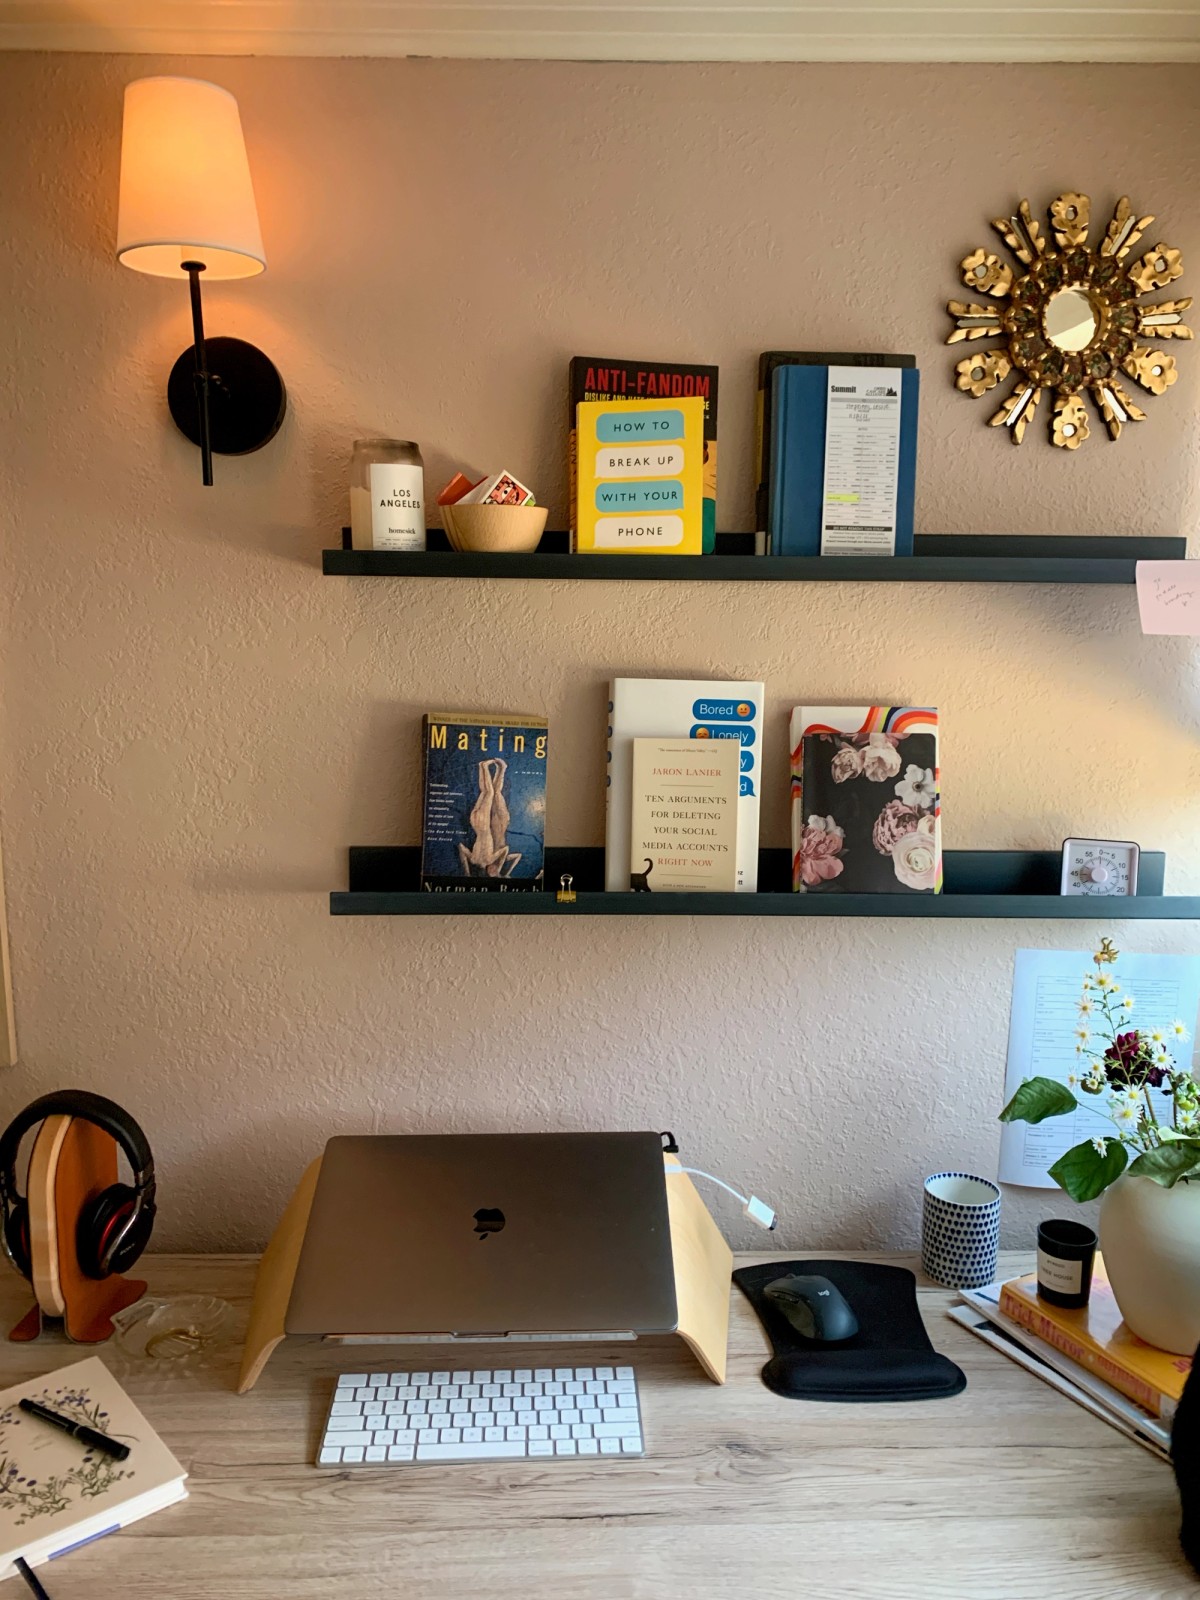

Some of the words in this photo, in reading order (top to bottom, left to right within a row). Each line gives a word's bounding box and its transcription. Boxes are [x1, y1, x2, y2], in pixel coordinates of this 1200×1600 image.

[584, 368, 710, 398] ANTI-FANDOM
[831, 385, 856, 393] Summit
[584, 392, 610, 401] DISLIKE
[614, 422, 646, 432] HOW
[652, 421, 670, 430] TO
[609, 457, 650, 467] BREAK
[657, 456, 674, 465] UP
[393, 489, 411, 497] LOS
[602, 492, 636, 502] WITH
[644, 491, 678, 500] YOUR
[380, 499, 421, 508] ANGELES
[618, 526, 663, 536] PHONE
[700, 704, 733, 715] Bored
[431, 725, 547, 758] Mating
[712, 730, 748, 743] Lonely
[686, 769, 722, 777] LANIER
[667, 795, 727, 804] ARGUMENTS
[651, 810, 669, 819] FOR
[672, 811, 721, 820] DELETING
[654, 826, 679, 835] YOUR
[682, 827, 718, 836] SOCIAL
[642, 842, 673, 850] MEDIA
[678, 843, 729, 852] ACCOUNTS
[658, 858, 688, 866] RIGHT
[691, 859, 714, 867] NOW
[1005, 1293, 1035, 1326] Trick
[1039, 1316, 1085, 1359] Mirror
